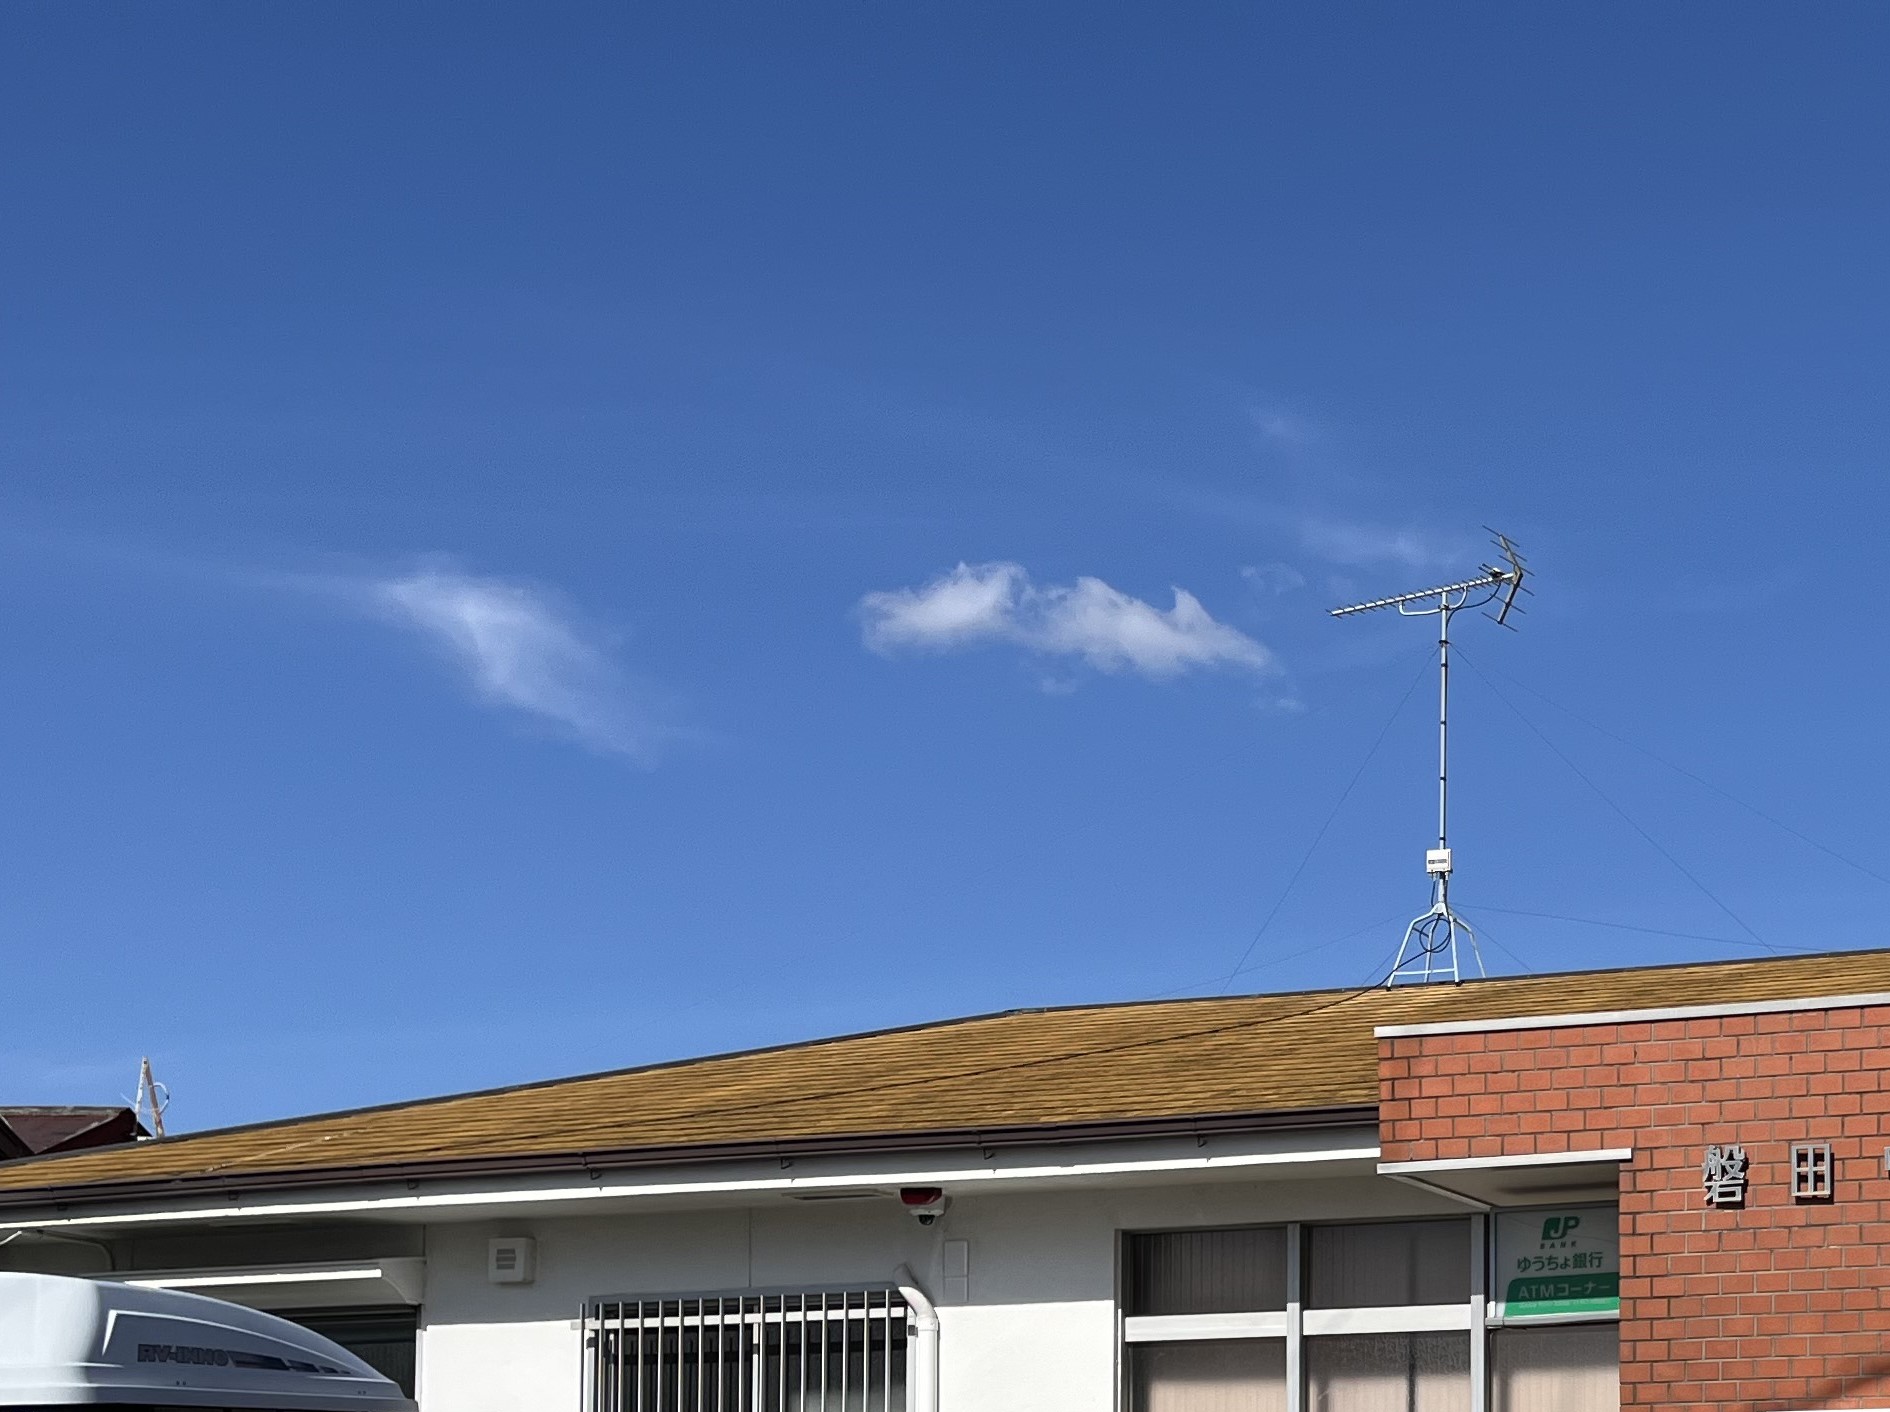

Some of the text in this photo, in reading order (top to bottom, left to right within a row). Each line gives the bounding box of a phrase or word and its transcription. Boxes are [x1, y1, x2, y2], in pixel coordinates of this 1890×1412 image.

[1540, 1240, 1577, 1250] BANK
[1517, 1251, 1604, 1273] ゆうちょ銀行
[1518, 1281, 1611, 1299] ATMコーナー
